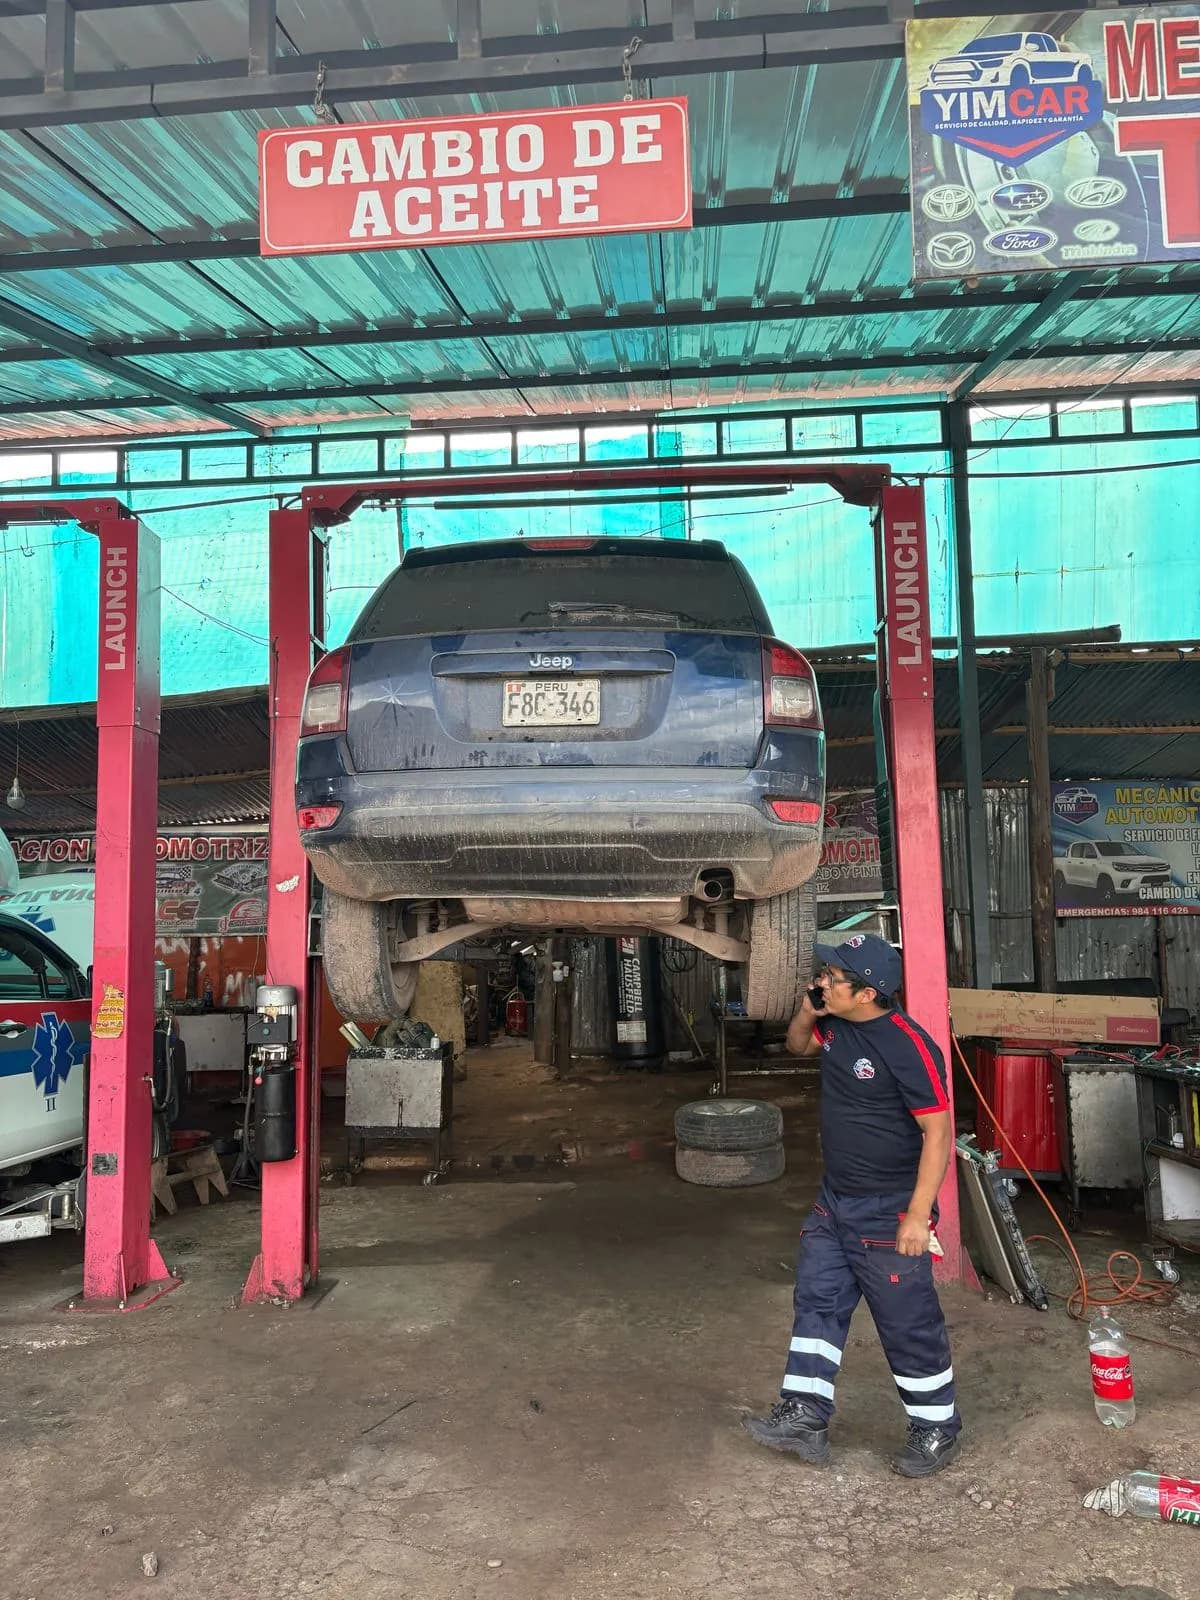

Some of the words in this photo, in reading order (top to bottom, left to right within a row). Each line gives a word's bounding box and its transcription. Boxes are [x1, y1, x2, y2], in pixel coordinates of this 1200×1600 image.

[932, 85, 1090, 122] YIMCAR
[934, 122, 968, 130] SERVICIO
[968, 121, 978, 129] DE
[978, 119, 1012, 128] CALIDAD,
[1011, 117, 1042, 126] RAPIDEZ
[285, 124, 545, 188] CAMBIO
[572, 113, 663, 168] DE
[348, 174, 600, 239] ACEITE
[1002, 233, 1040, 250] Ford
[892, 521, 923, 665] LAUNCH
[104, 546, 128, 671] LAUNCH
[529, 653, 573, 669] Jeep
[535, 682, 569, 692] PERU
[1124, 829, 1174, 842] SERVICIO
[1175, 829, 1191, 841] DE
[1139, 886, 1182, 900] CAMBIO
[1184, 886, 1199, 899] DE
[1057, 907, 1129, 917] EMERGENCIAS:
[1132, 907, 1150, 916] 984
[1151, 906, 1169, 915] 116
[1171, 905, 1189, 914] 426
[631, 958, 643, 1014] CAMPBELL
